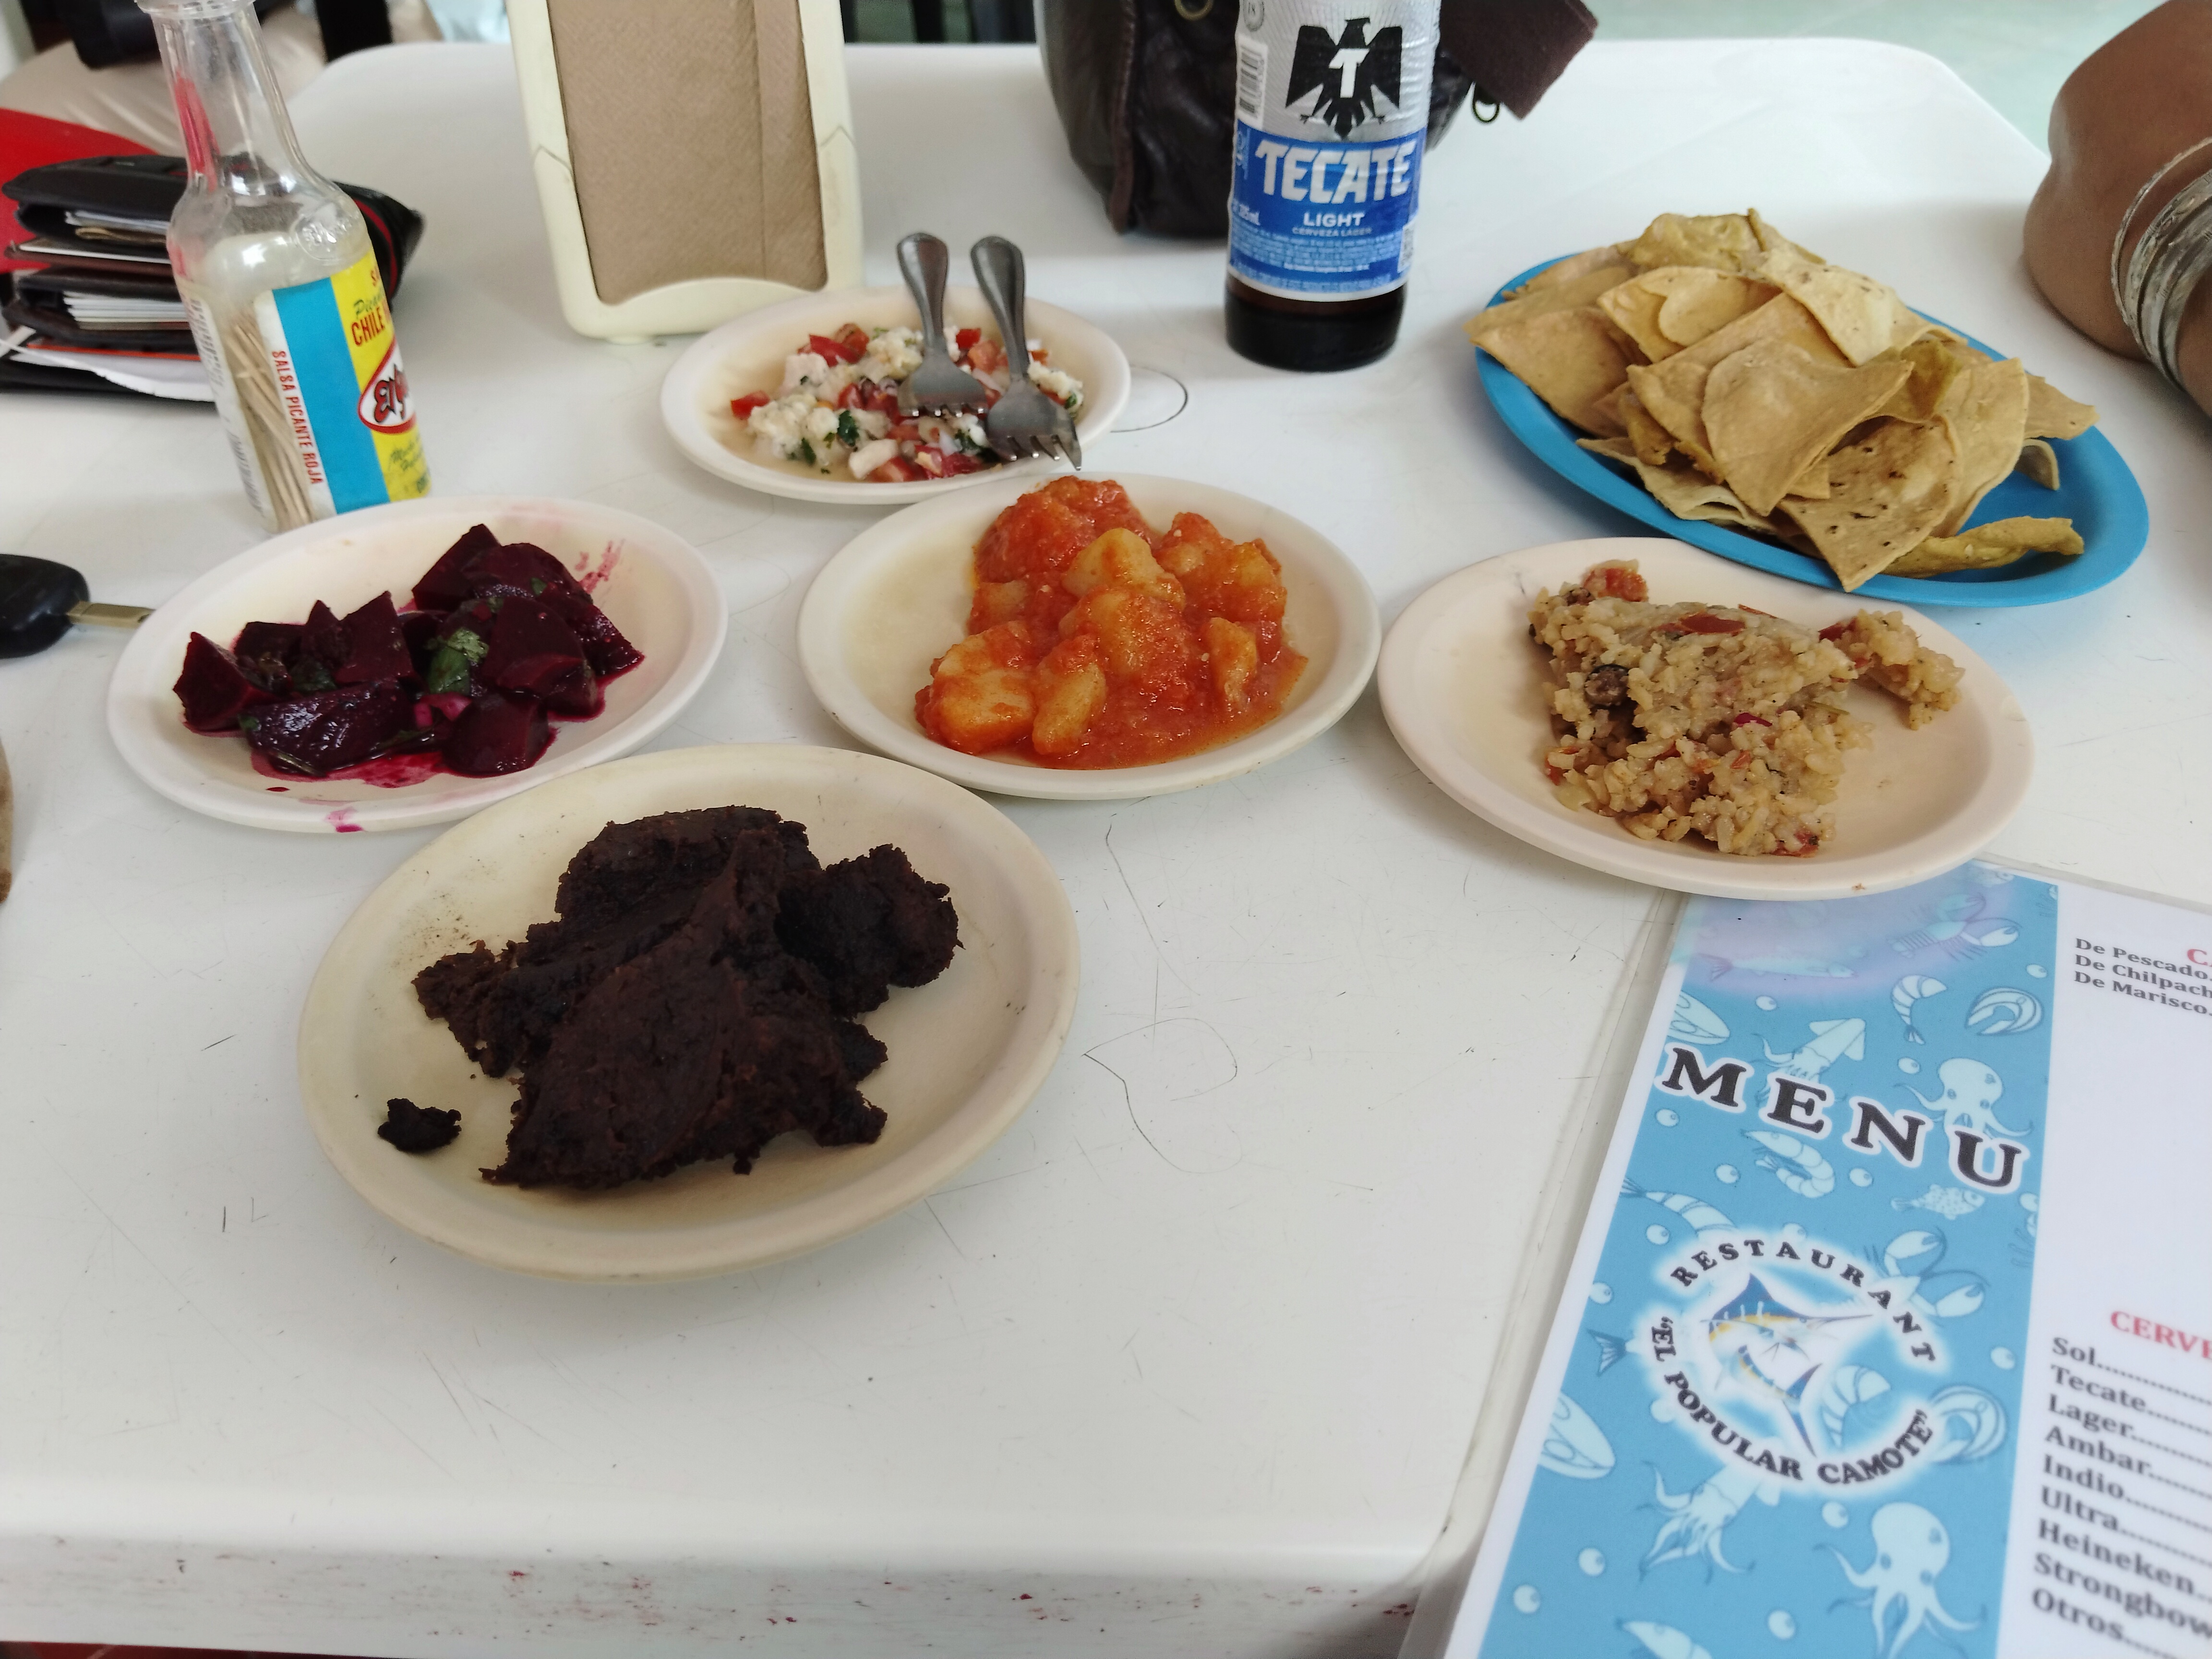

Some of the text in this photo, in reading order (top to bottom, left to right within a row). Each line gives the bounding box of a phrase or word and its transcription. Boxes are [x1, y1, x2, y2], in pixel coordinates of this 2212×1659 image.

[1255, 139, 1417, 204] TECATE
[1292, 227, 1339, 237] CERVEZA
[1303, 211, 1366, 227] LIGHT
[351, 306, 385, 347] CHILE
[272, 350, 324, 484] SALSA PICANTE ROJA
[2075, 938, 2105, 954] De
[2187, 948, 2212, 967] C
[2074, 971, 2105, 988] De
[2075, 954, 2212, 998] De Chilpach
[1661, 1046, 2022, 1187] MENU
[1670, 1238, 1936, 1362] RESTAURANT
[1664, 1370, 1803, 1481] POPULAR
